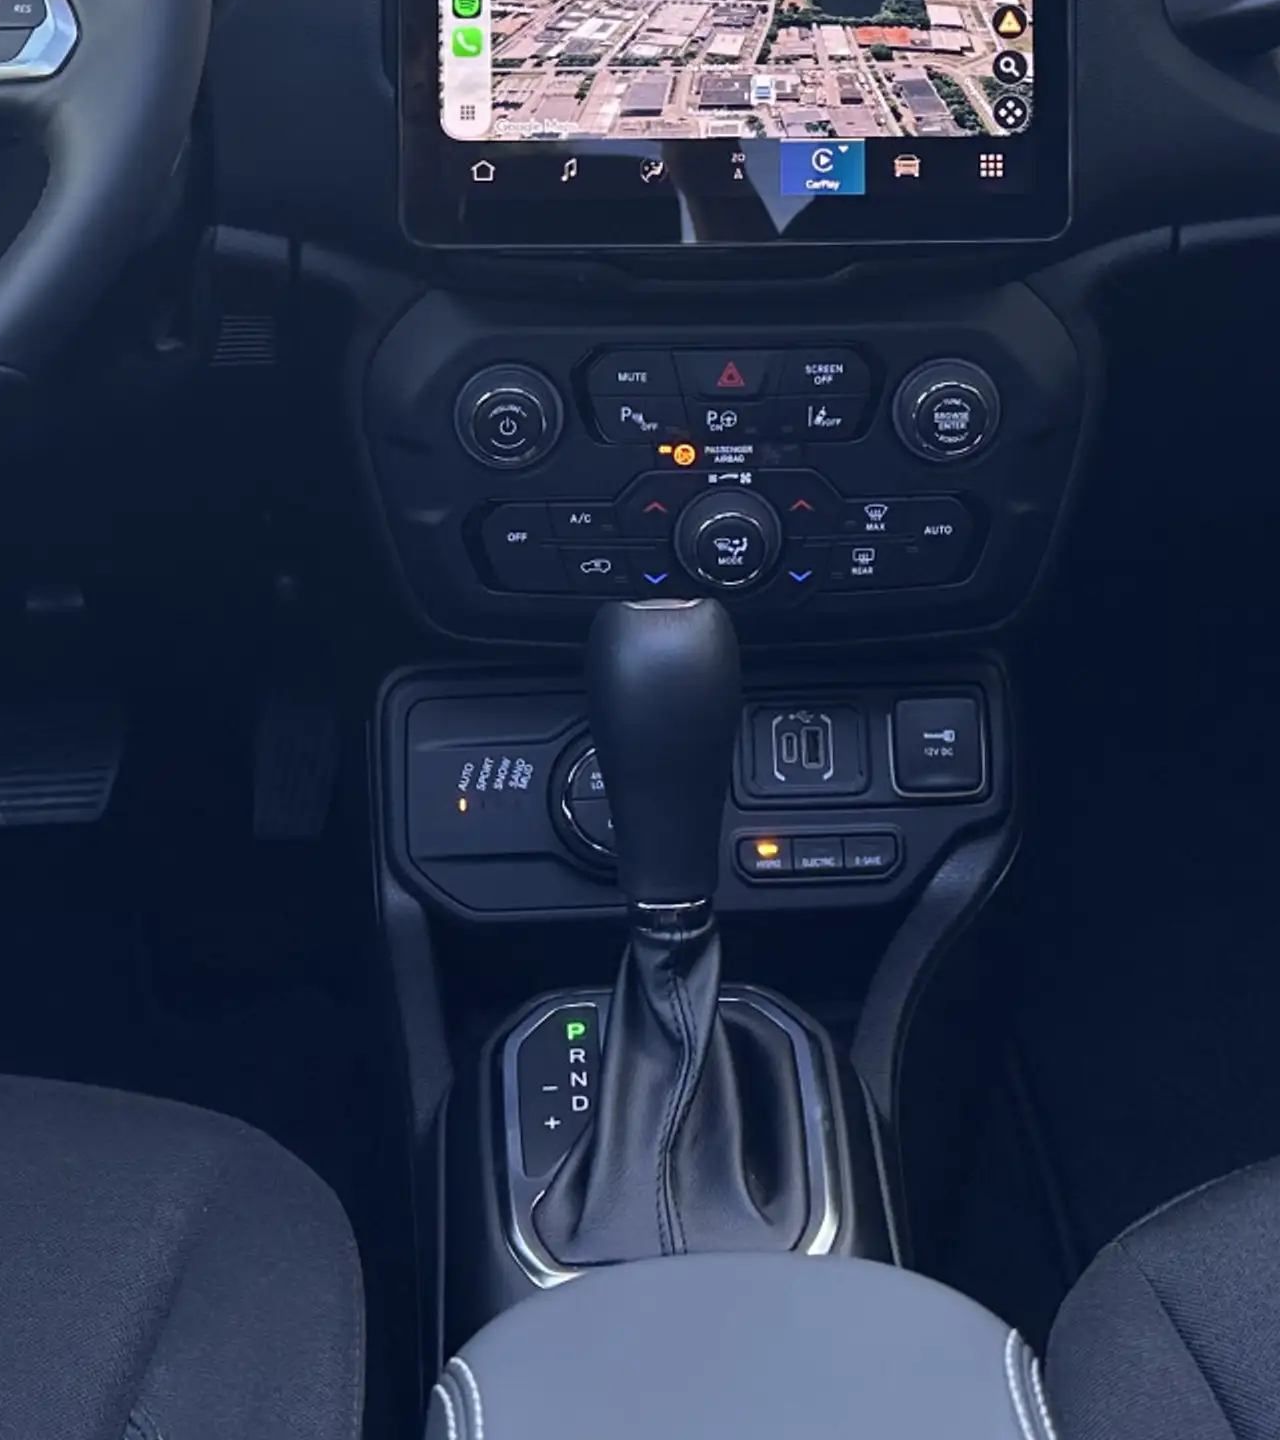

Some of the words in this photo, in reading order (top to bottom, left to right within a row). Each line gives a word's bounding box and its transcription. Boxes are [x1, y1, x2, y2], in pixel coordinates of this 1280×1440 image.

[13, 3, 32, 14] RES
[805, 178, 841, 192] CarPlay
[618, 371, 647, 382] MUTE
[805, 364, 844, 374] SCREEN
[814, 375, 833, 385] OFF
[569, 513, 592, 524] A/C
[507, 531, 527, 542] OFF
[924, 525, 953, 536] AUTO
[458, 761, 475, 792] AUTO
[475, 756, 495, 792] SPORT
[493, 756, 511, 791] SNOW
[508, 758, 526, 789] SAND
[518, 763, 534, 790] MUD
[567, 1022, 586, 1041] P
[569, 1047, 586, 1064] R
[570, 1071, 588, 1087] N
[571, 1095, 589, 1112] D
